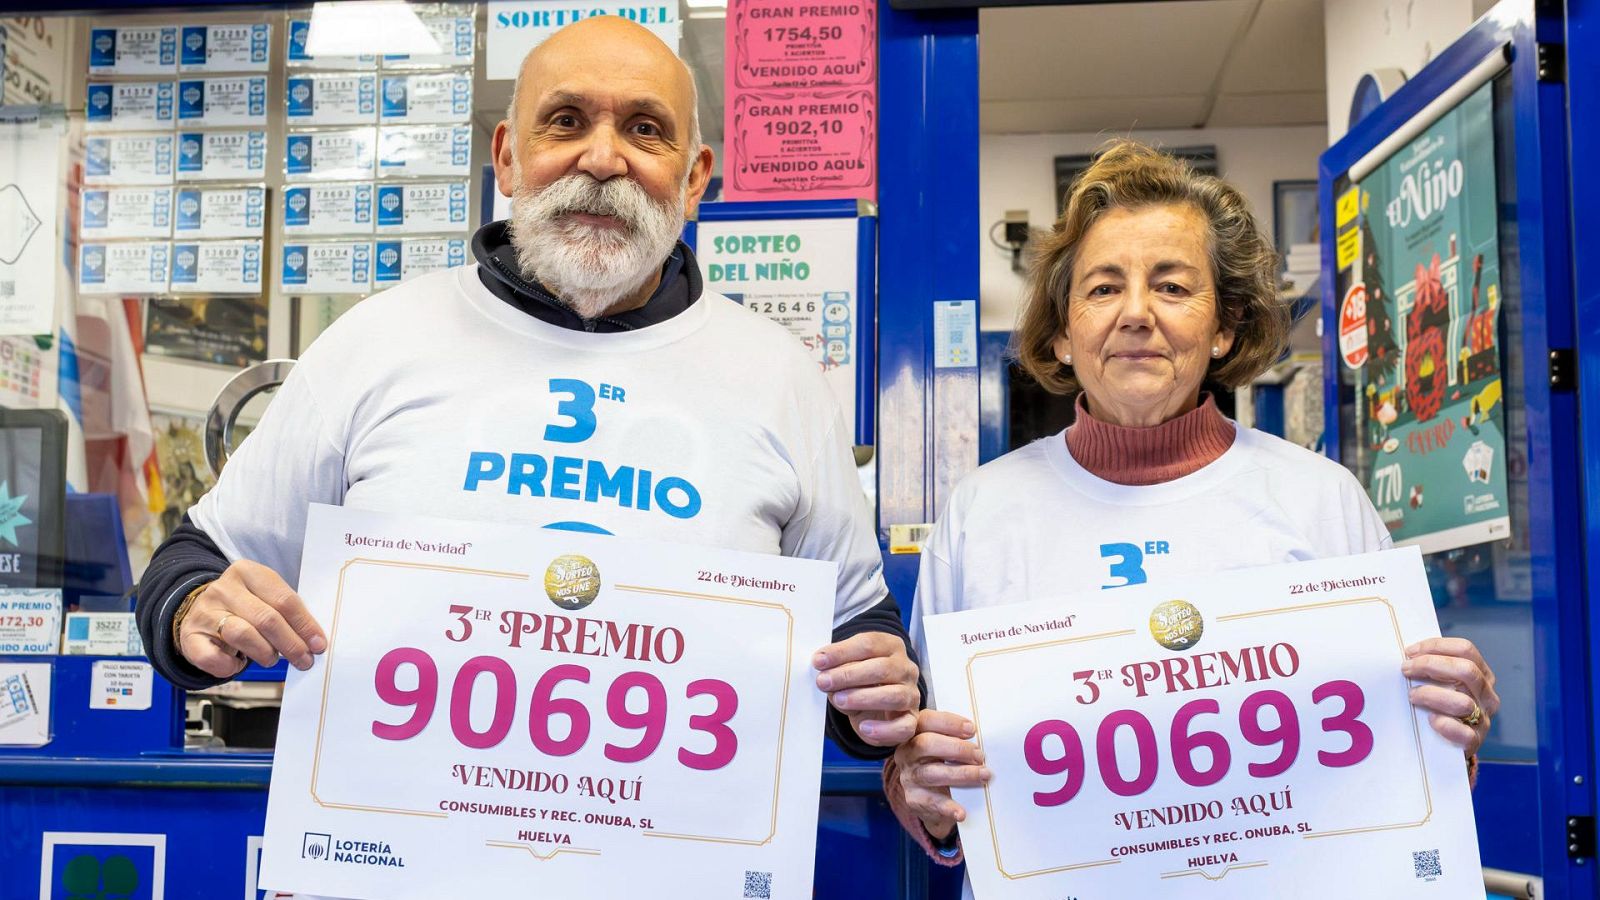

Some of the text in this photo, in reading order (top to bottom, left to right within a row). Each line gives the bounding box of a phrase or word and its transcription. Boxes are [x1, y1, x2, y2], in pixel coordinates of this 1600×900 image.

[750, 4, 860, 19] GRAN PREMIO
[763, 26, 842, 42] 1754,50
[749, 65, 818, 77] VENDIDO
[749, 103, 859, 117] GRAN PREMIO
[763, 120, 844, 138] 1902,10
[750, 161, 818, 173] VENDIDO
[316, 189, 350, 198] 78693
[410, 190, 445, 198] 03523
[409, 245, 444, 254] 14274
[713, 234, 802, 254] SORTEO
[313, 249, 348, 258] 60704
[708, 258, 811, 282] DEL NIÑO
[462, 451, 702, 519] PREMIO
[1375, 463, 1402, 506] 770
[396, 539, 412, 550] de
[414, 541, 473, 556] Navidad
[697, 570, 797, 593] 22 de Diciembre
[1288, 574, 1386, 595] 22 de Diciembre
[12, 602, 52, 610] PREMIO
[95, 621, 122, 630] 35227
[1006, 625, 1022, 638] de
[1023, 614, 1077, 634] Navidad
[498, 610, 686, 665] PREMIO
[1121, 642, 1300, 698] PREMIO
[371, 647, 740, 771] 90693
[1023, 679, 1375, 807] 90693
[451, 764, 643, 804] VENDIDO AQUÍ
[439, 800, 655, 830] CONSUMIBLES Y REC. ONUBA, SL
[1114, 785, 1292, 831] VENDIDO AQUÍ
[517, 830, 572, 845] HUELVA
[1110, 822, 1312, 857] CONSUMIBLES Y REC. ONUBA, SL
[336, 839, 392, 854] LOTERÍA
[334, 852, 406, 867] NACIONAL
[1187, 853, 1239, 868] HUELVA
